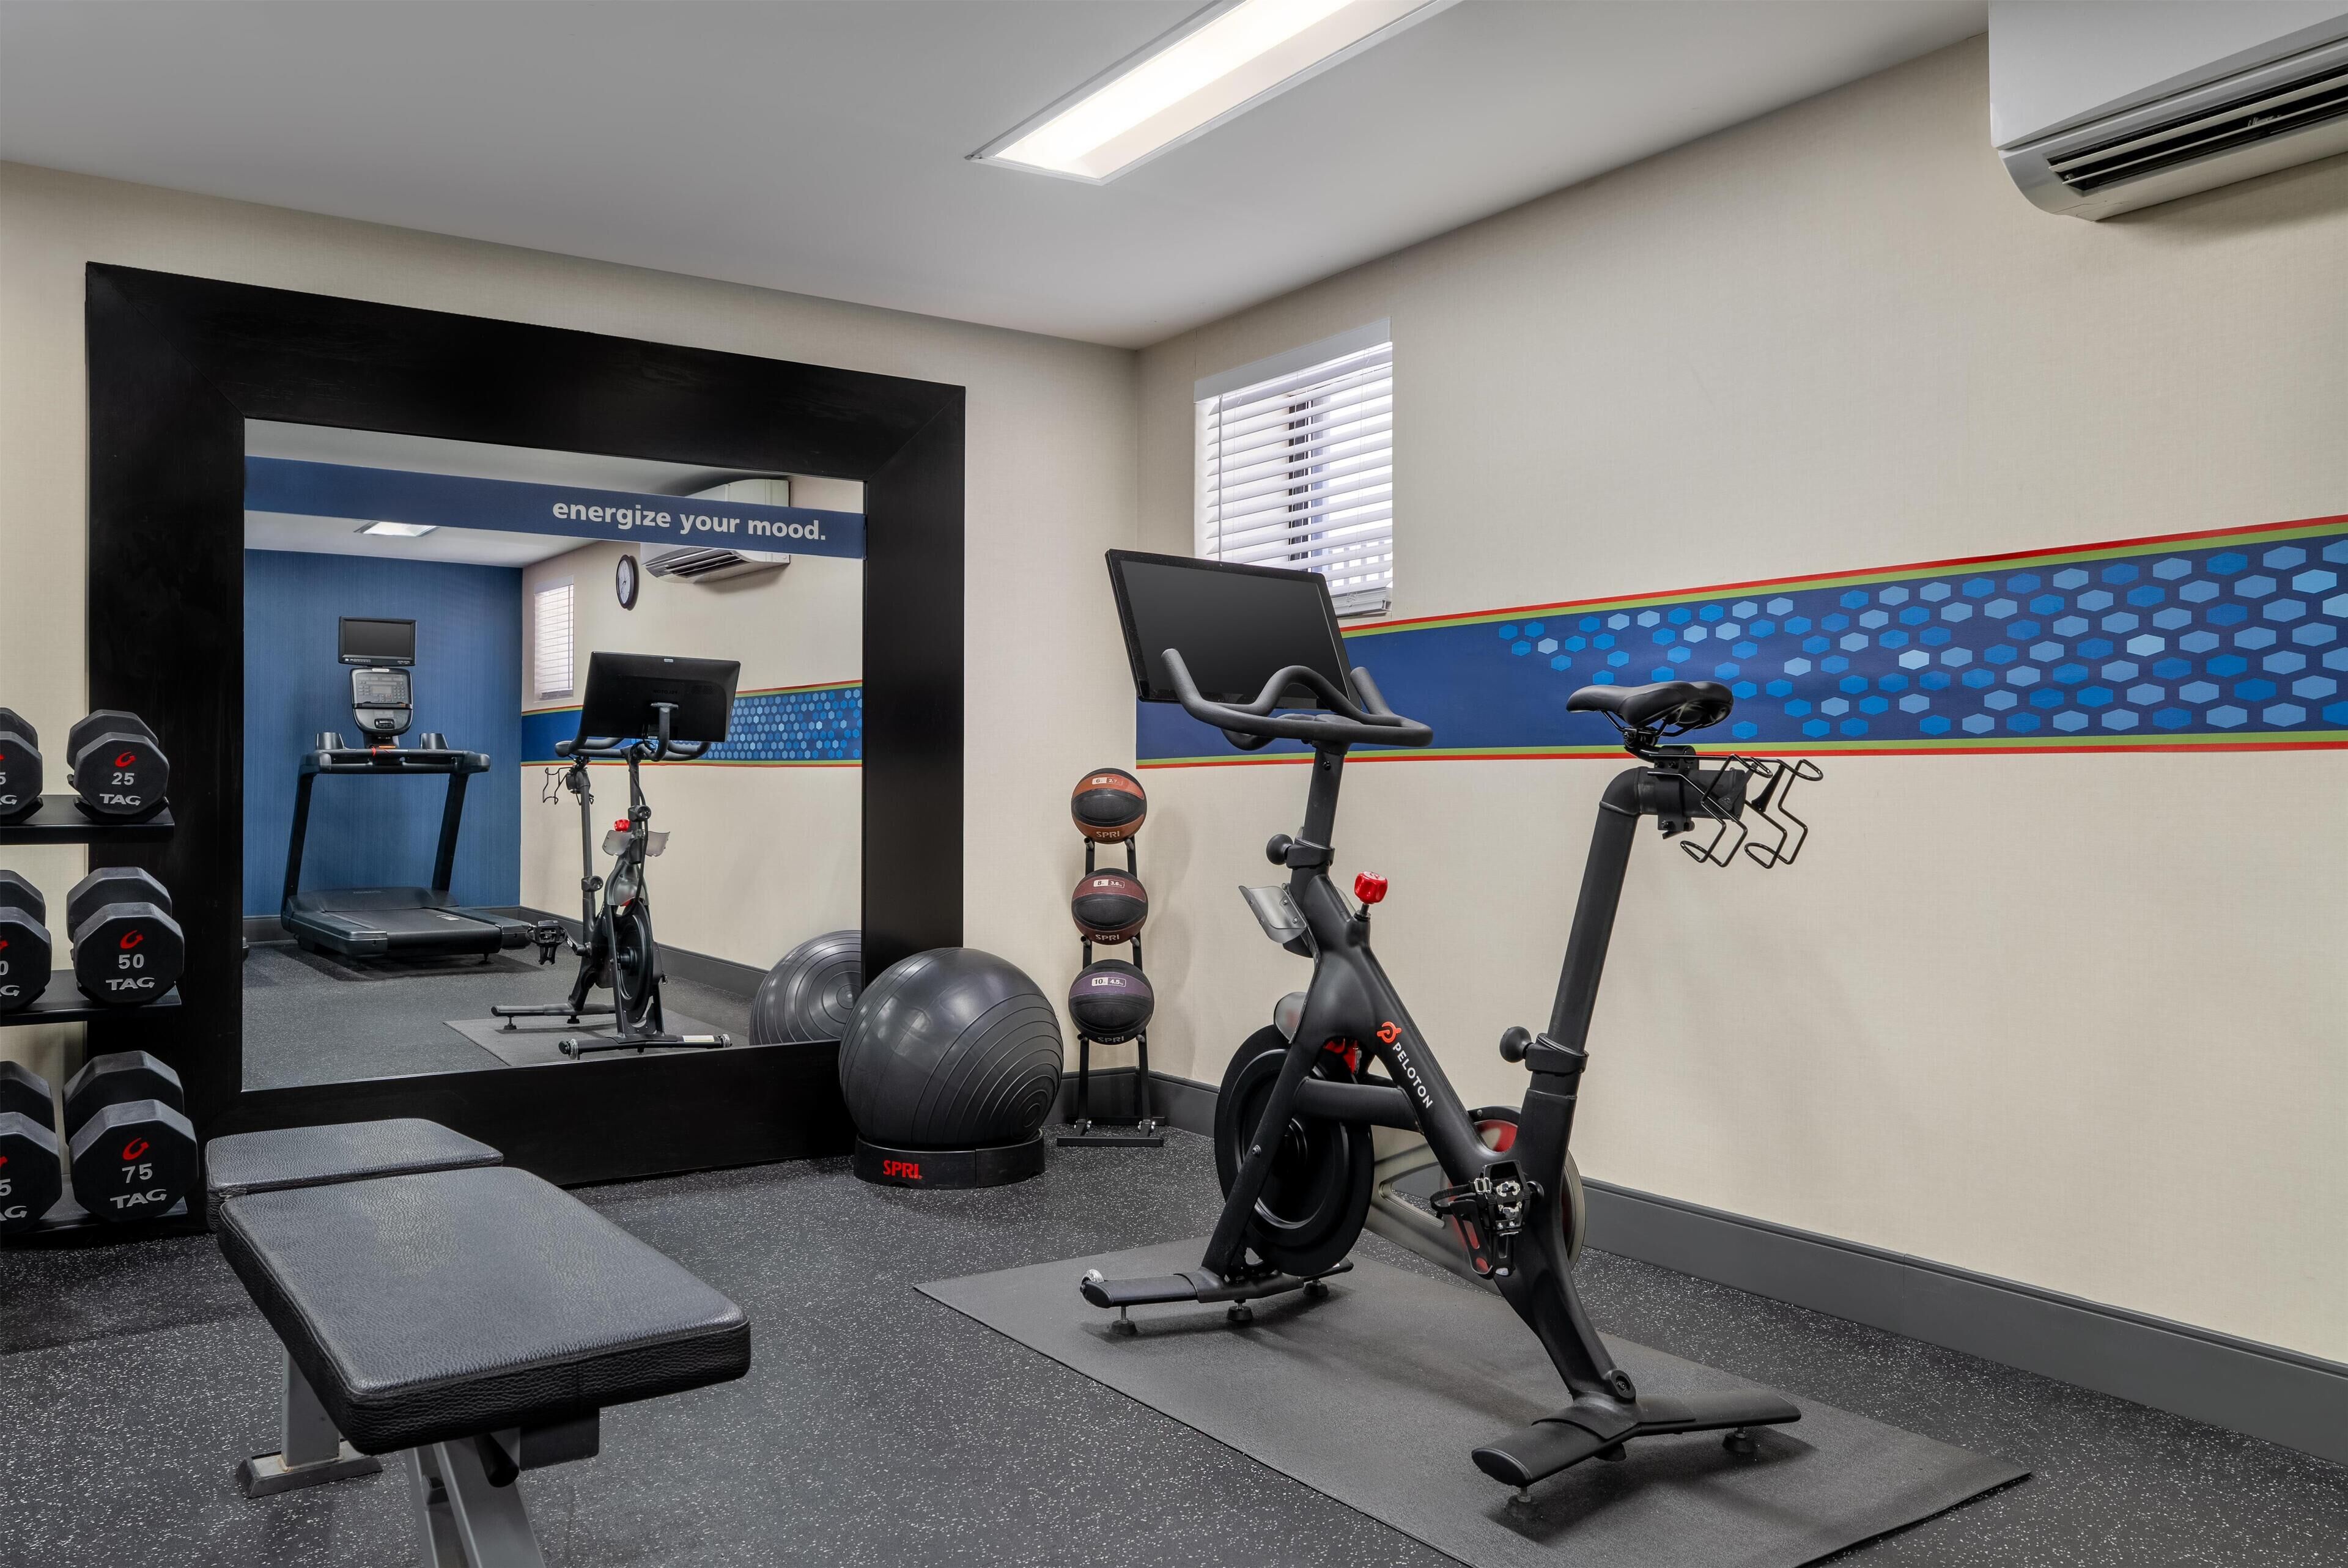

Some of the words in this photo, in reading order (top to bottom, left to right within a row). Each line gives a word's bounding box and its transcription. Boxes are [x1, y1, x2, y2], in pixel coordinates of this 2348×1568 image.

[552, 502, 671, 530] energize
[679, 513, 739, 534] your
[748, 520, 826, 540] mood.
[111, 771, 135, 786] 25
[99, 793, 141, 806] TAG
[118, 954, 144, 969] 50
[106, 977, 155, 990] TAG
[1392, 1042, 1433, 1109] PELOTON
[122, 1163, 152, 1183] 75
[883, 1160, 920, 1179] SPRI
[110, 1188, 167, 1209] TAG
